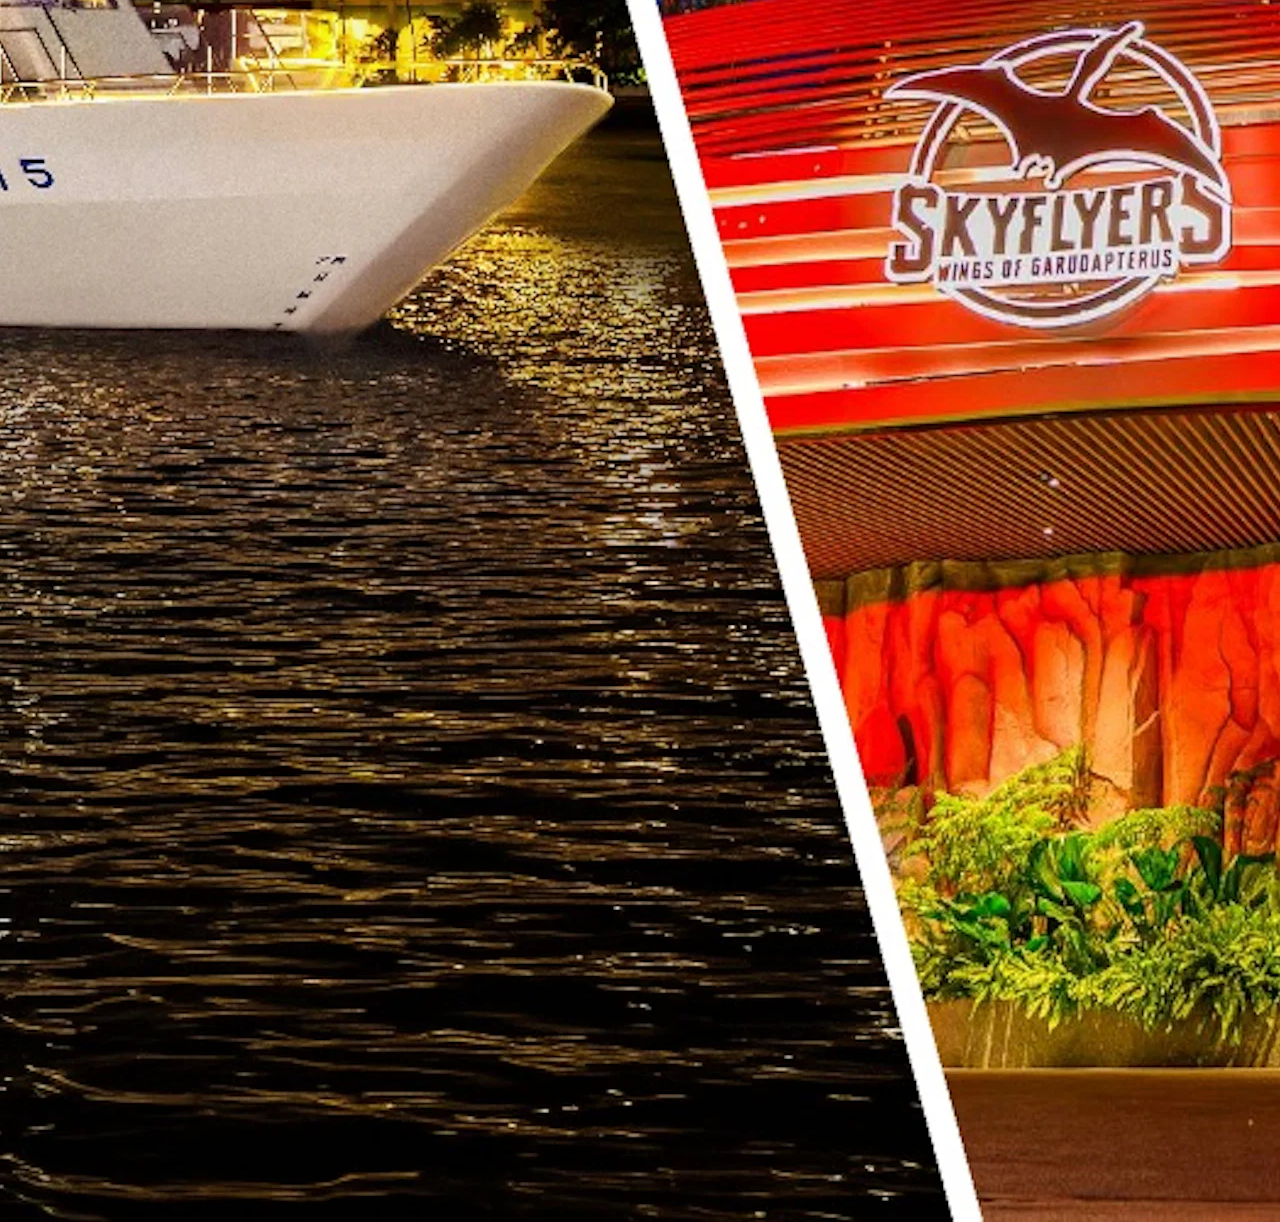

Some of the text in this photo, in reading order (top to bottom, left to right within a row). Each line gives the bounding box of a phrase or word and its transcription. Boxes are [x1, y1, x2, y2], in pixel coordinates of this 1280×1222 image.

[19, 158, 54, 189] 5
[892, 174, 1224, 275] SKYFLYERS
[938, 248, 1174, 282] WINGS OF GARUDAPTERUS
